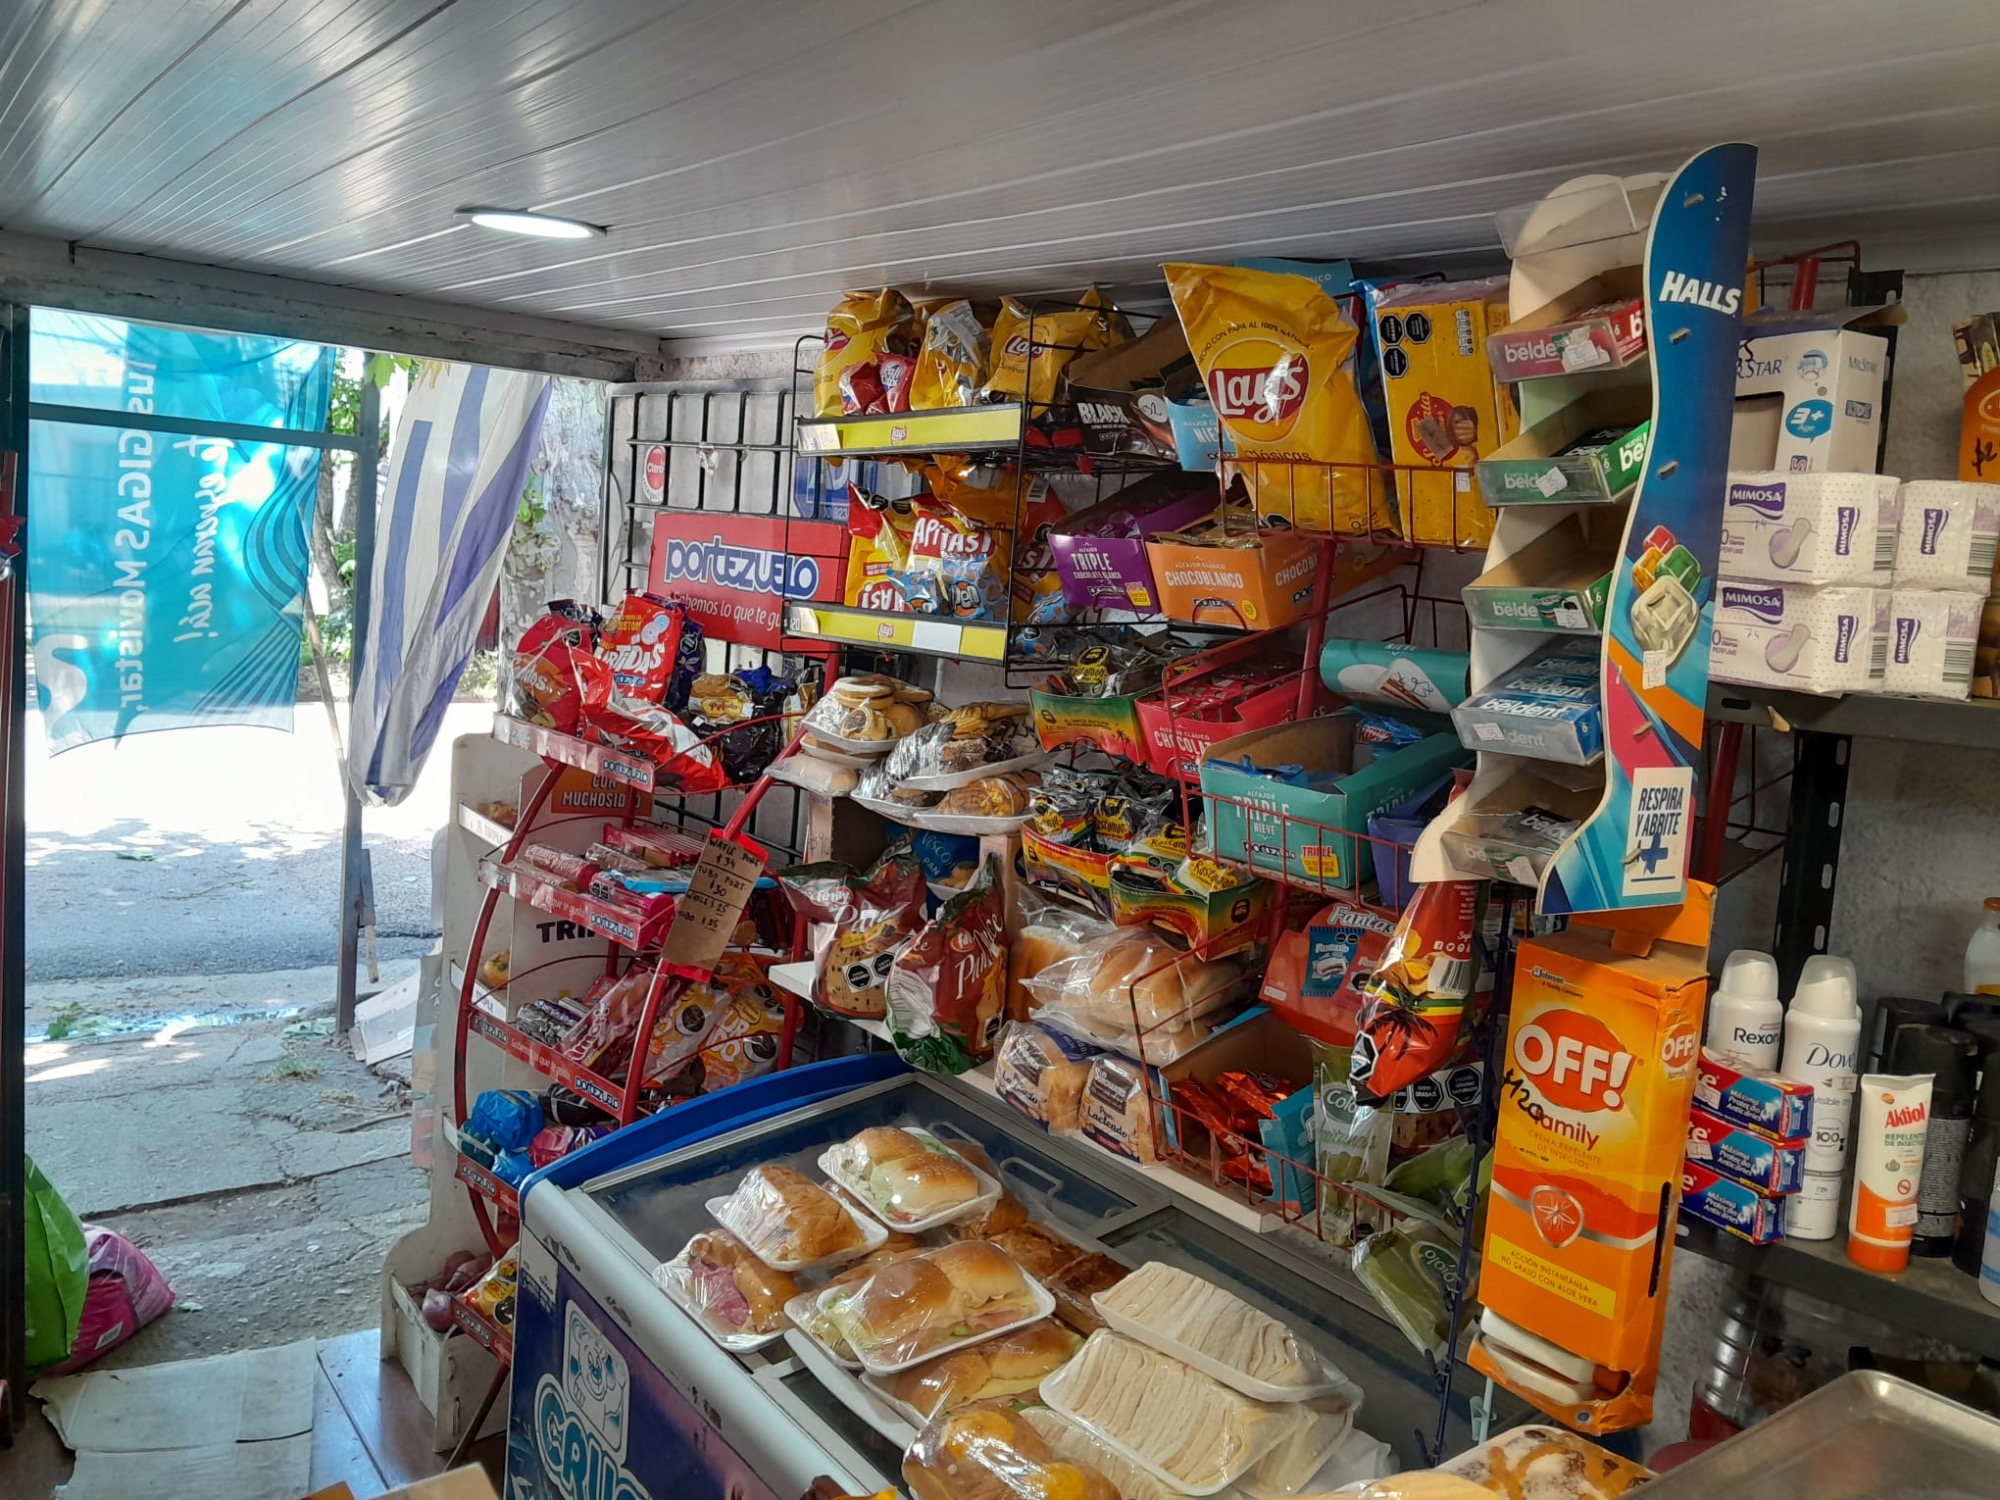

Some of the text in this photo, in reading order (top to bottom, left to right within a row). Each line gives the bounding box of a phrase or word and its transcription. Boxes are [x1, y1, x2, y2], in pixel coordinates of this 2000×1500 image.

[1659, 270, 1742, 315] HALLS
[1227, 322, 1247, 335] PAPA
[1504, 340, 1559, 363] belde
[1077, 402, 1132, 425] BLACK
[1602, 458, 1611, 470] 6
[1731, 489, 1783, 503] MIMOSA
[1838, 509, 1850, 554] MIMOSA
[1923, 509, 1937, 554] MIMOSA
[1070, 553, 1113, 571] TRIPLE
[1165, 571, 1244, 589] CHOCOBLANCO
[673, 591, 718, 615] Sabemos
[720, 601, 732, 618] lo
[733, 604, 754, 625] que
[756, 609, 767, 623] te
[1493, 601, 1539, 618] belde
[1724, 592, 1781, 608] MIMOSA
[1837, 617, 1850, 662] MIMOSA
[1896, 619, 1911, 663] MIMOSA
[1479, 698, 1568, 719] beldent
[1581, 721, 1589, 733] 6
[1247, 790, 1276, 800] ALFAJOR
[1638, 787, 1684, 812] RESPIRA
[1233, 795, 1292, 826] TRIPLE
[1253, 822, 1276, 836] NIEVE
[1635, 812, 1682, 838] Y ABRITE
[922, 857, 942, 876] PAN
[589, 912, 635, 941] portezuelo
[1327, 903, 1396, 936] Fantas
[1661, 1030, 1697, 1062] OFF!
[1513, 1023, 1633, 1108] OFF!
[574, 1075, 621, 1111] portezuelo
[1087, 1105, 1128, 1138] Lacteado
[1884, 1101, 1926, 1129] Aktiol
[1527, 1128, 1557, 1145] CREMA
[1557, 1140, 1601, 1165] REPELENTE
[1815, 1130, 1841, 1144] 100
[1884, 1139, 1895, 1147] DE
[1536, 1143, 1548, 1153] DE
[1549, 1147, 1590, 1170] INSECTOS
[1501, 1255, 1598, 1307] NO GRASO CON ALOE VERA
[1510, 1249, 1589, 1292] ACCIÓN INSTANTÁNEA
